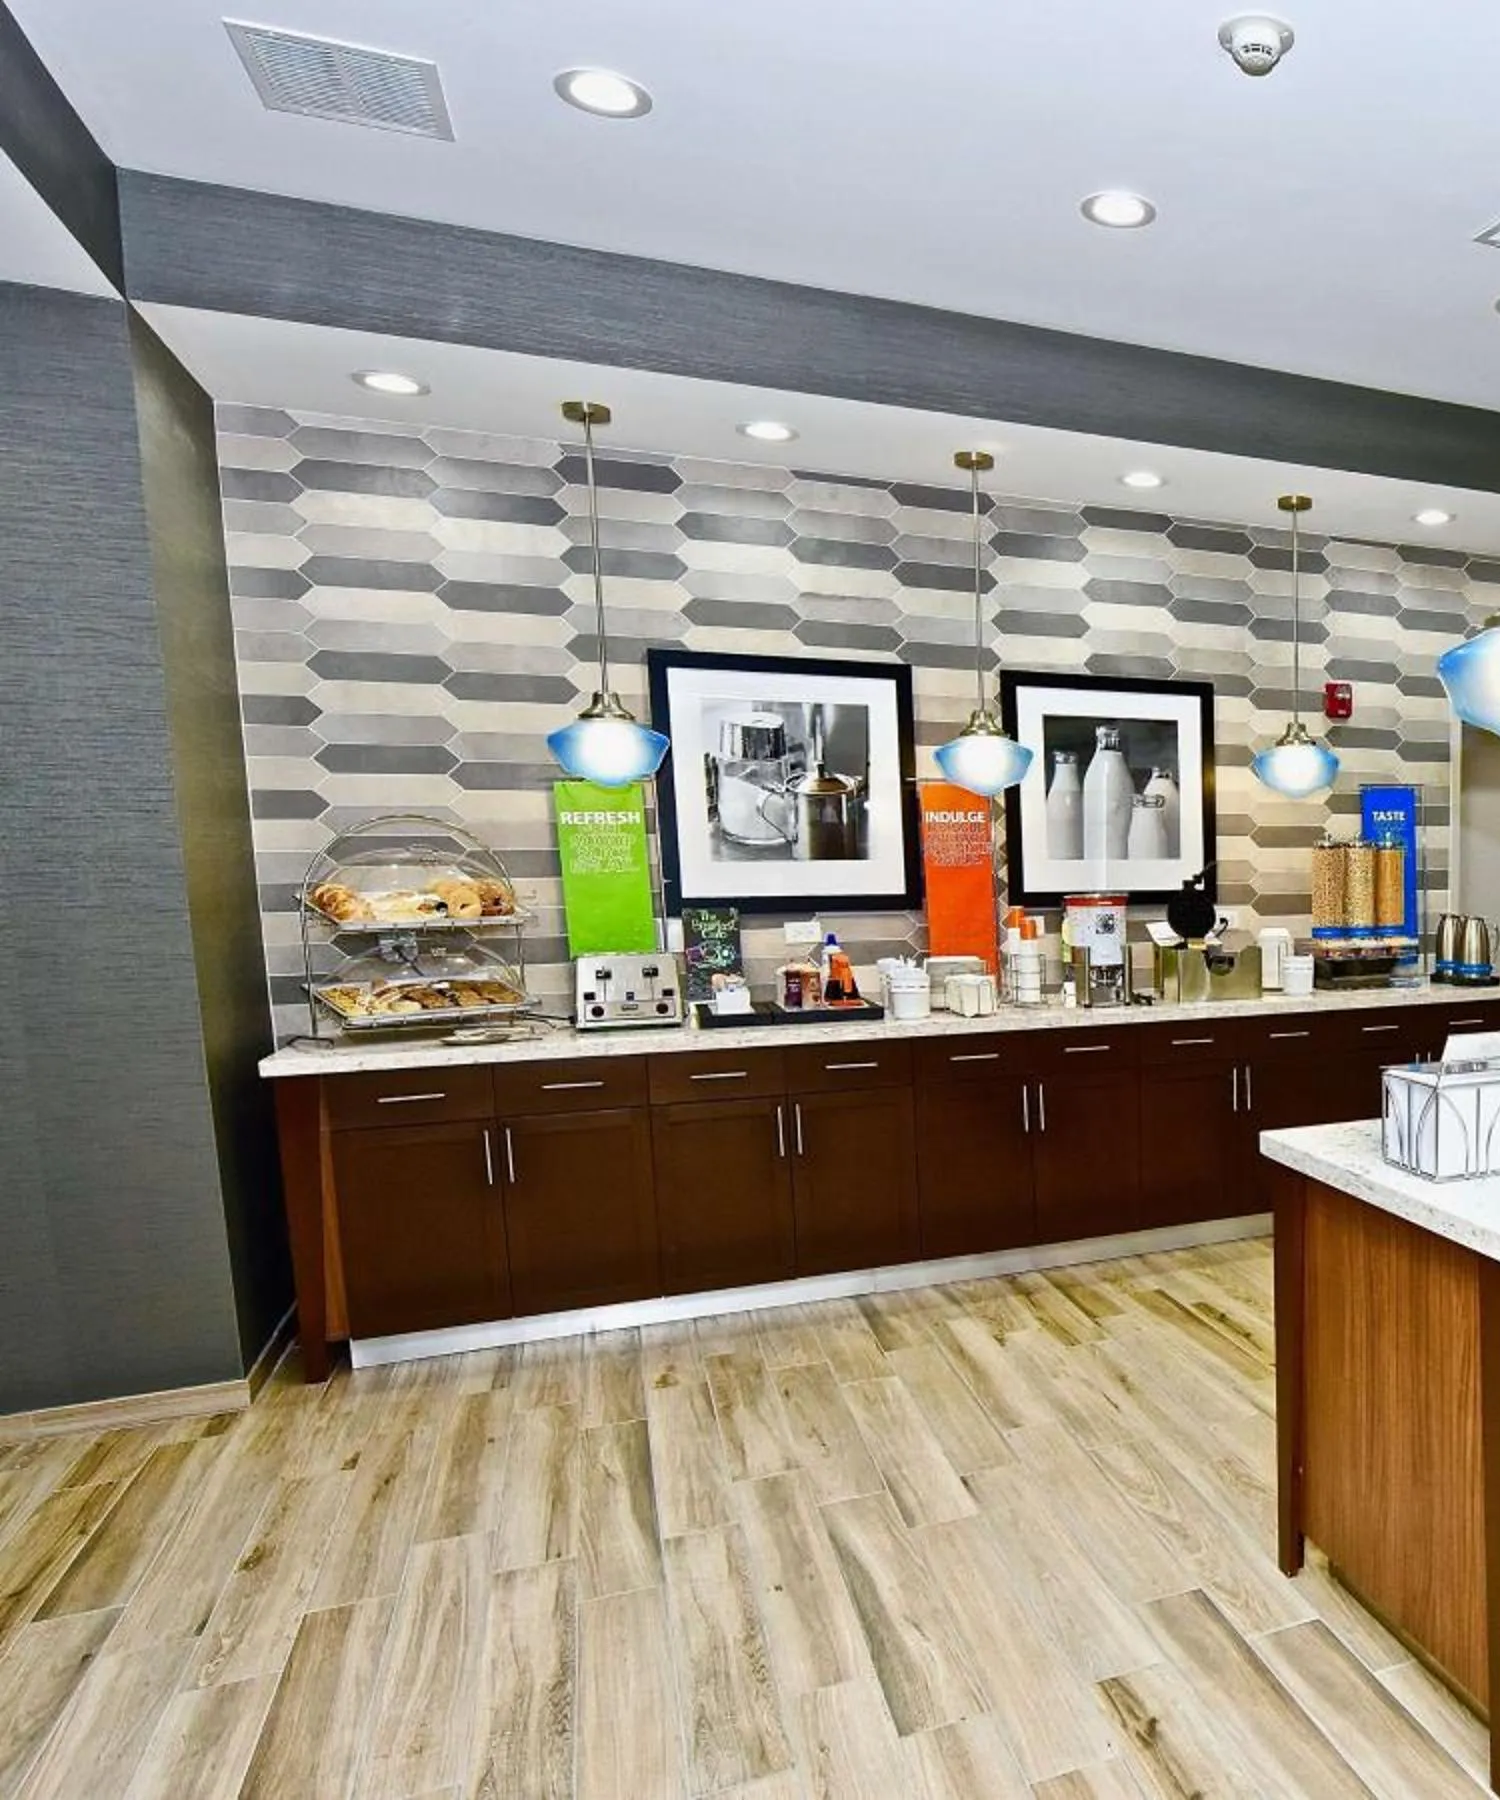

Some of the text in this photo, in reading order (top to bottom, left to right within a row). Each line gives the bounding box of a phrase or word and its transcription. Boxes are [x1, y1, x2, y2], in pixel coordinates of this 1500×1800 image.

[560, 811, 641, 825] REFRESH
[925, 811, 986, 823] INDULGE
[1372, 811, 1406, 822] TASTE
